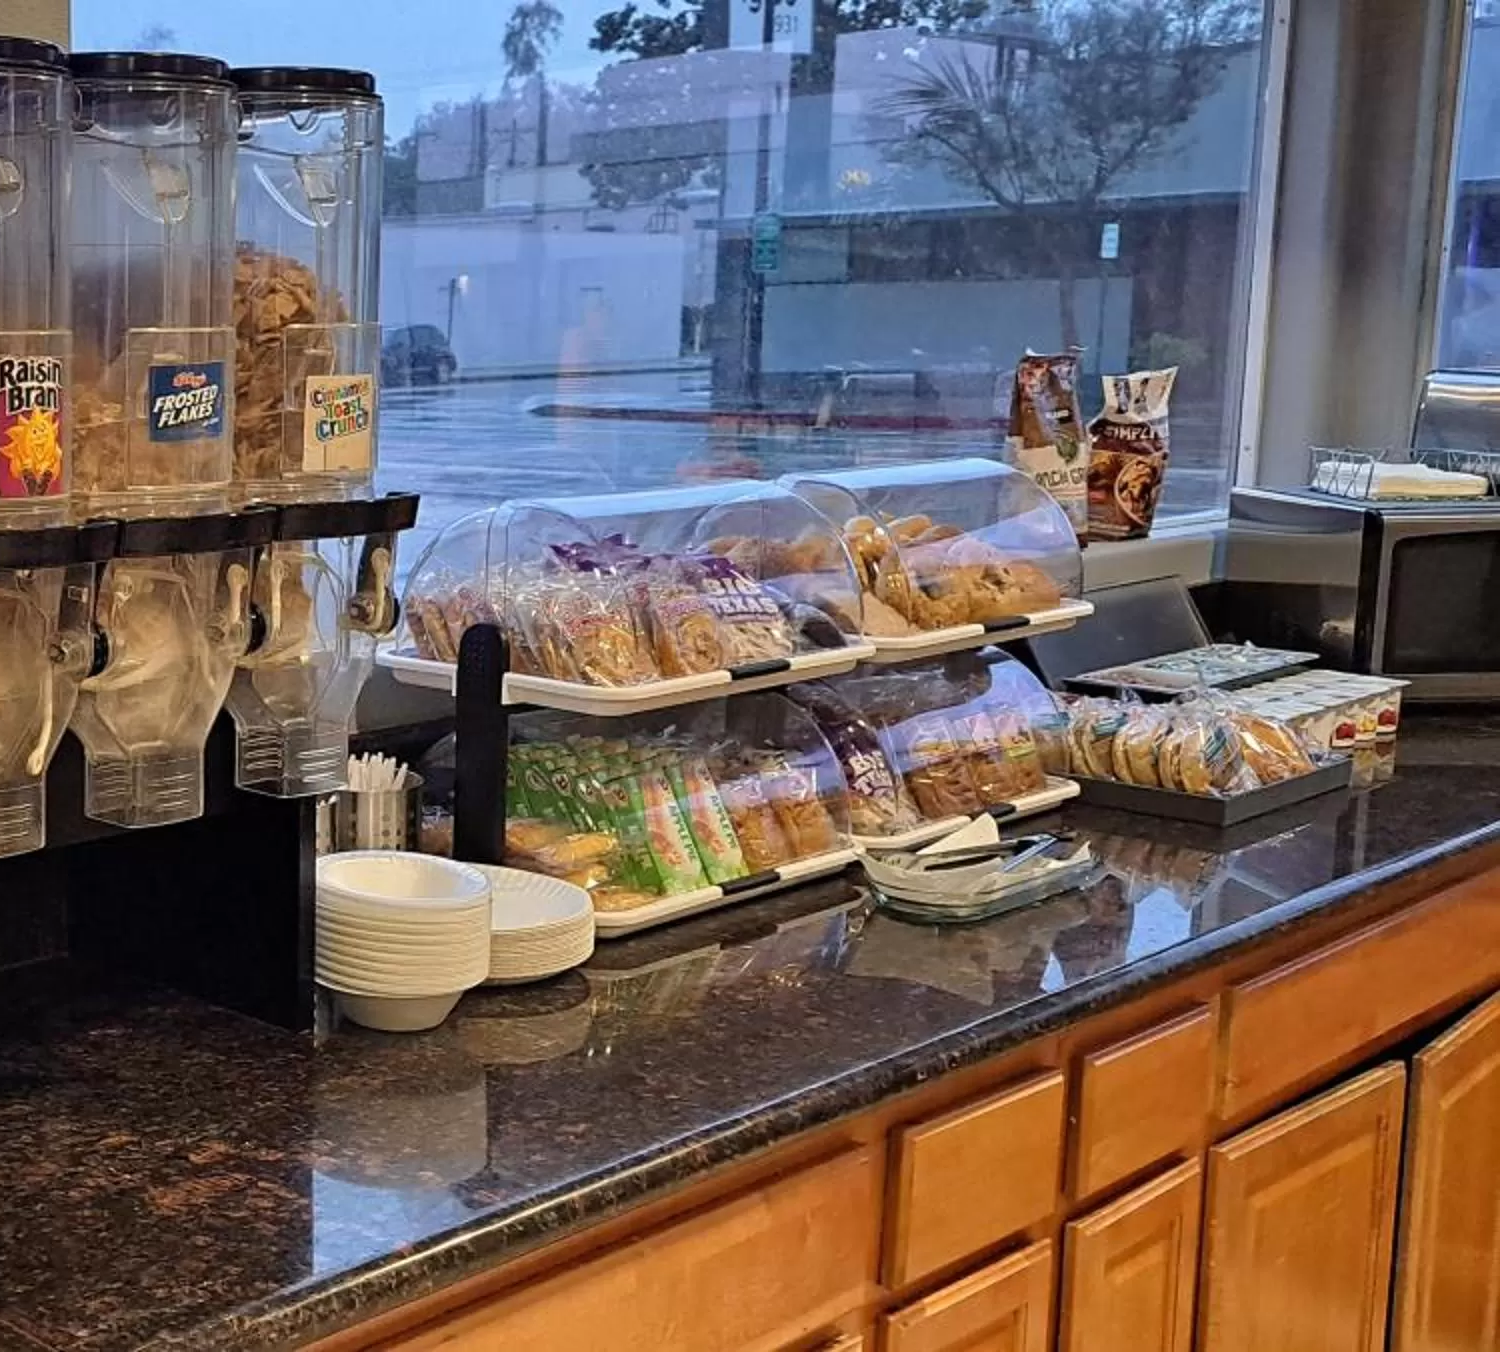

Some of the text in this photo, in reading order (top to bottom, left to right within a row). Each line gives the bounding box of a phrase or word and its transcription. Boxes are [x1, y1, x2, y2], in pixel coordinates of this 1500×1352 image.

[0, 357, 61, 389] Raisin
[7, 384, 59, 413] Bran
[152, 383, 219, 413] FROSTED
[157, 400, 214, 429] FLAKES
